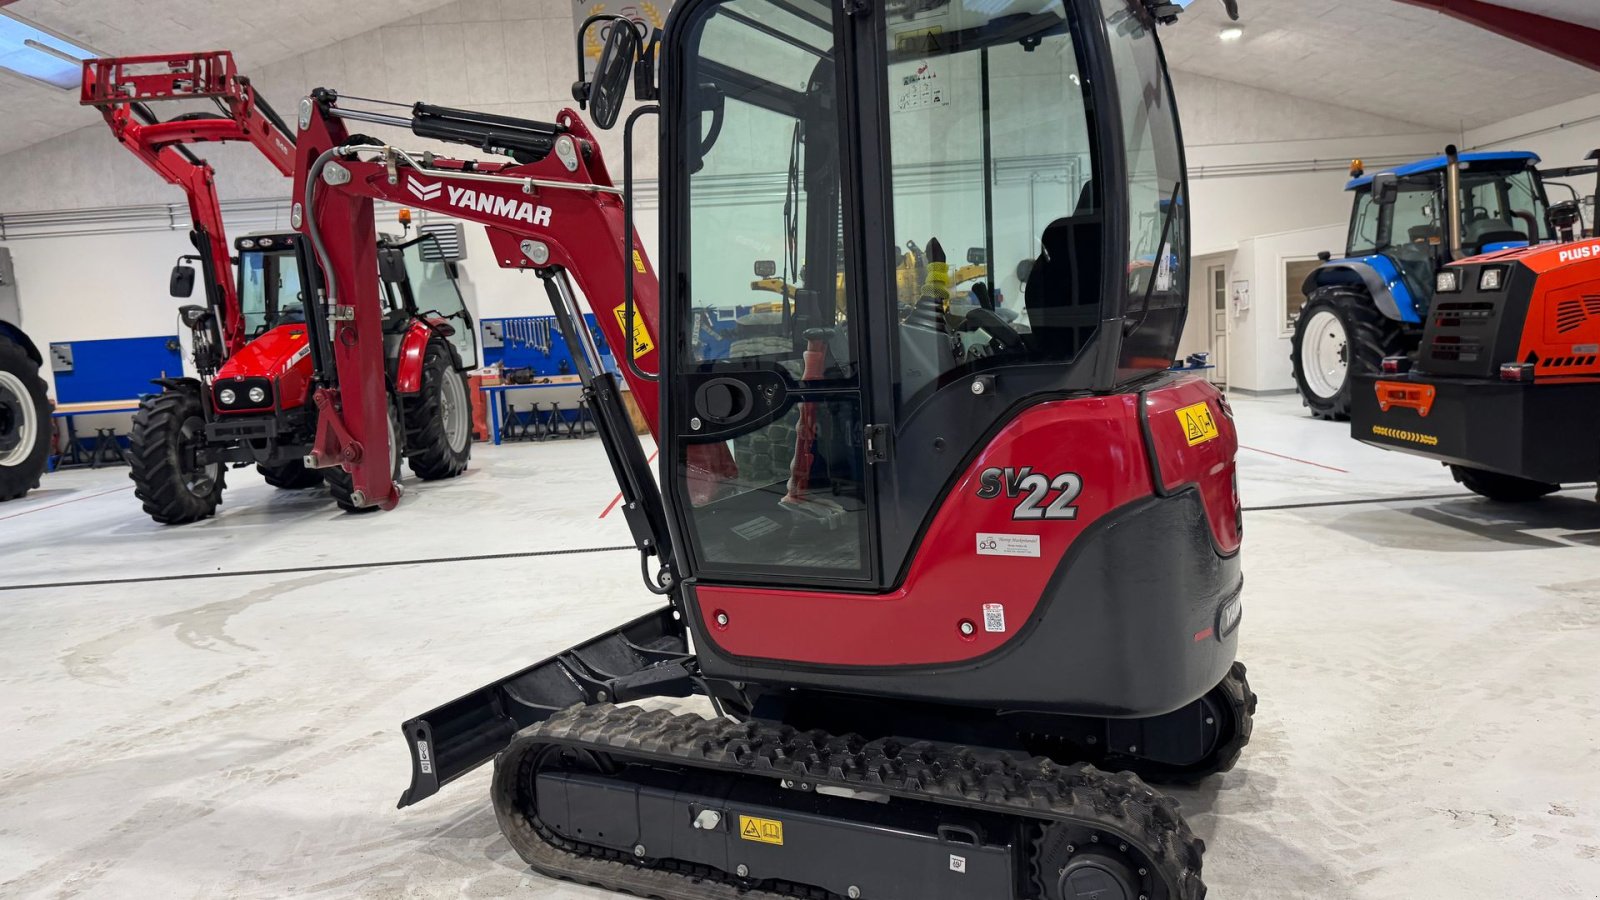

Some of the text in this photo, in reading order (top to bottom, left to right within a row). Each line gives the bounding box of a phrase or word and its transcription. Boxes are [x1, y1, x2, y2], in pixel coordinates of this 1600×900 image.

[447, 185, 553, 227] YANMAR
[1559, 245, 1600, 262] PLUS P
[976, 466, 1083, 520] SV22
